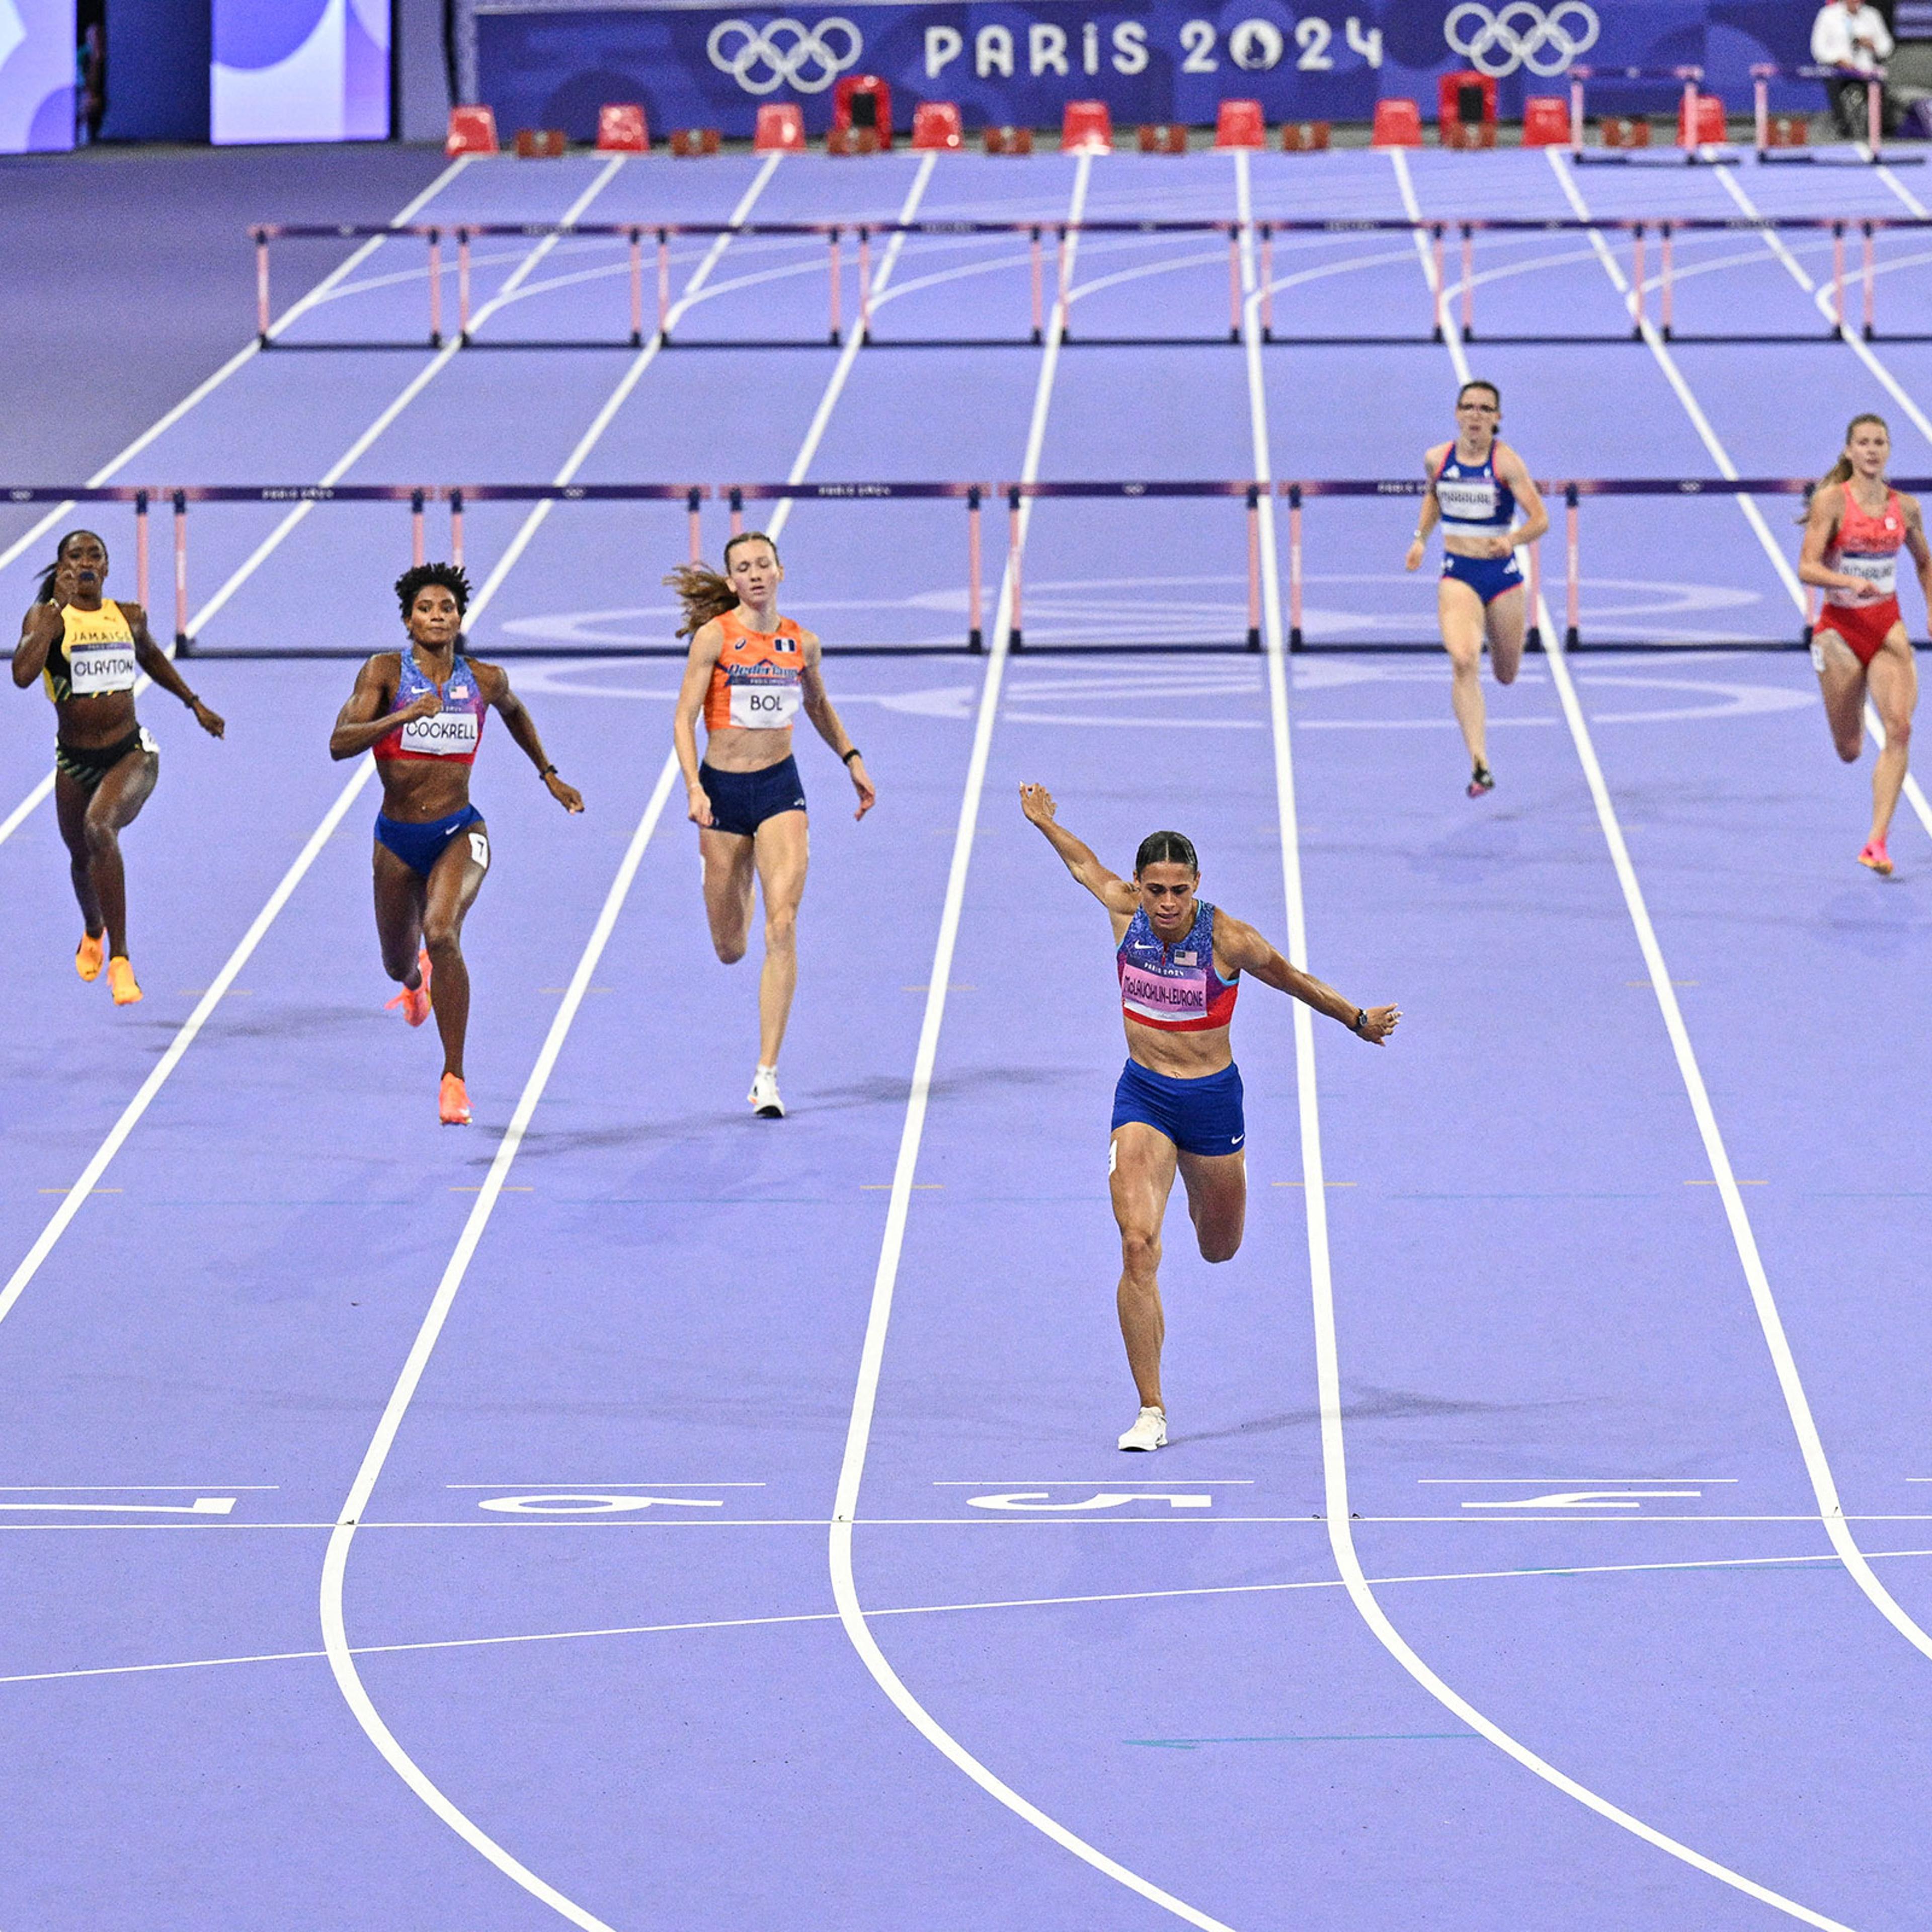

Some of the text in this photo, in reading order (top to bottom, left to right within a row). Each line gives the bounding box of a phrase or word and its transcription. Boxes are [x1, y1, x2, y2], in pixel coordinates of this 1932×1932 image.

[925, 16, 1383, 78] PARIS 2024
[71, 631, 131, 642] JAMAICA
[750, 695, 783, 711] BOL
[406, 721, 475, 740] COCKRELL
[477, 839, 484, 858] 7
[967, 1492, 1212, 1510] 5
